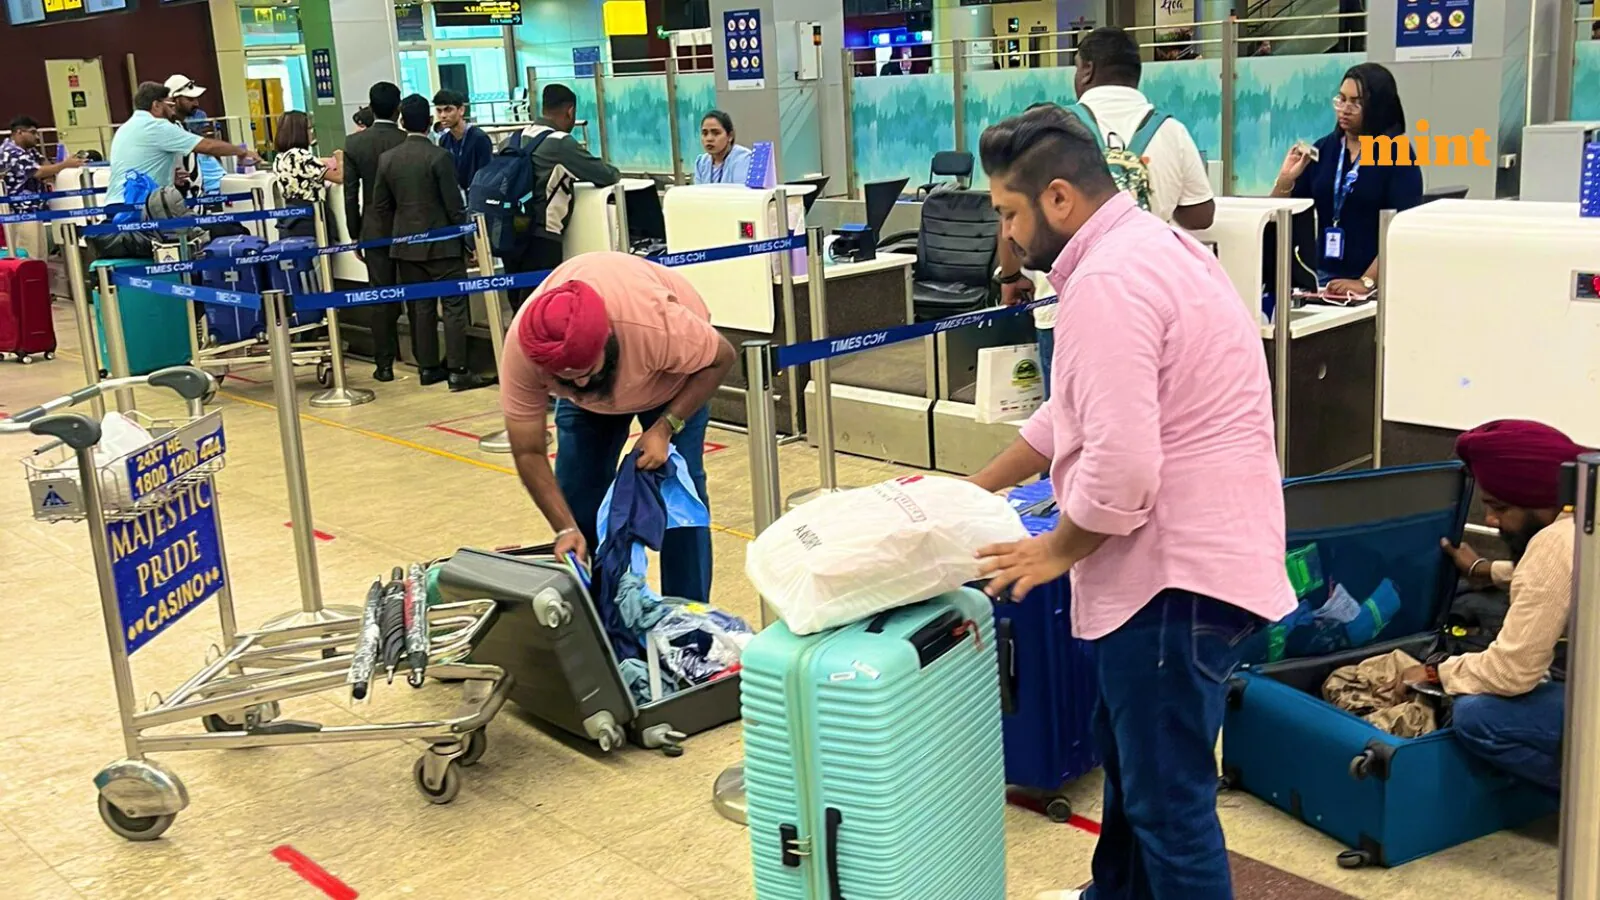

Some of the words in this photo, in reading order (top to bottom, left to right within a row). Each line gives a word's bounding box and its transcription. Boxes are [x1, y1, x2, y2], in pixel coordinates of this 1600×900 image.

[117, 223, 140, 231] TIMES
[747, 241, 773, 254] TIMES
[235, 255, 260, 265] TIMES
[658, 253, 685, 265] TIMES
[145, 263, 172, 275] TIMES
[458, 278, 490, 291] TIMES
[345, 290, 378, 304] TIMES
[933, 320, 962, 332] TIMES
[830, 336, 862, 353] TIMES
[136, 464, 168, 495] 1800
[169, 450, 198, 477] 1200
[110, 480, 211, 564] MAJESTIC
[136, 530, 201, 597] PRIDE
[144, 573, 204, 631] CASINO
